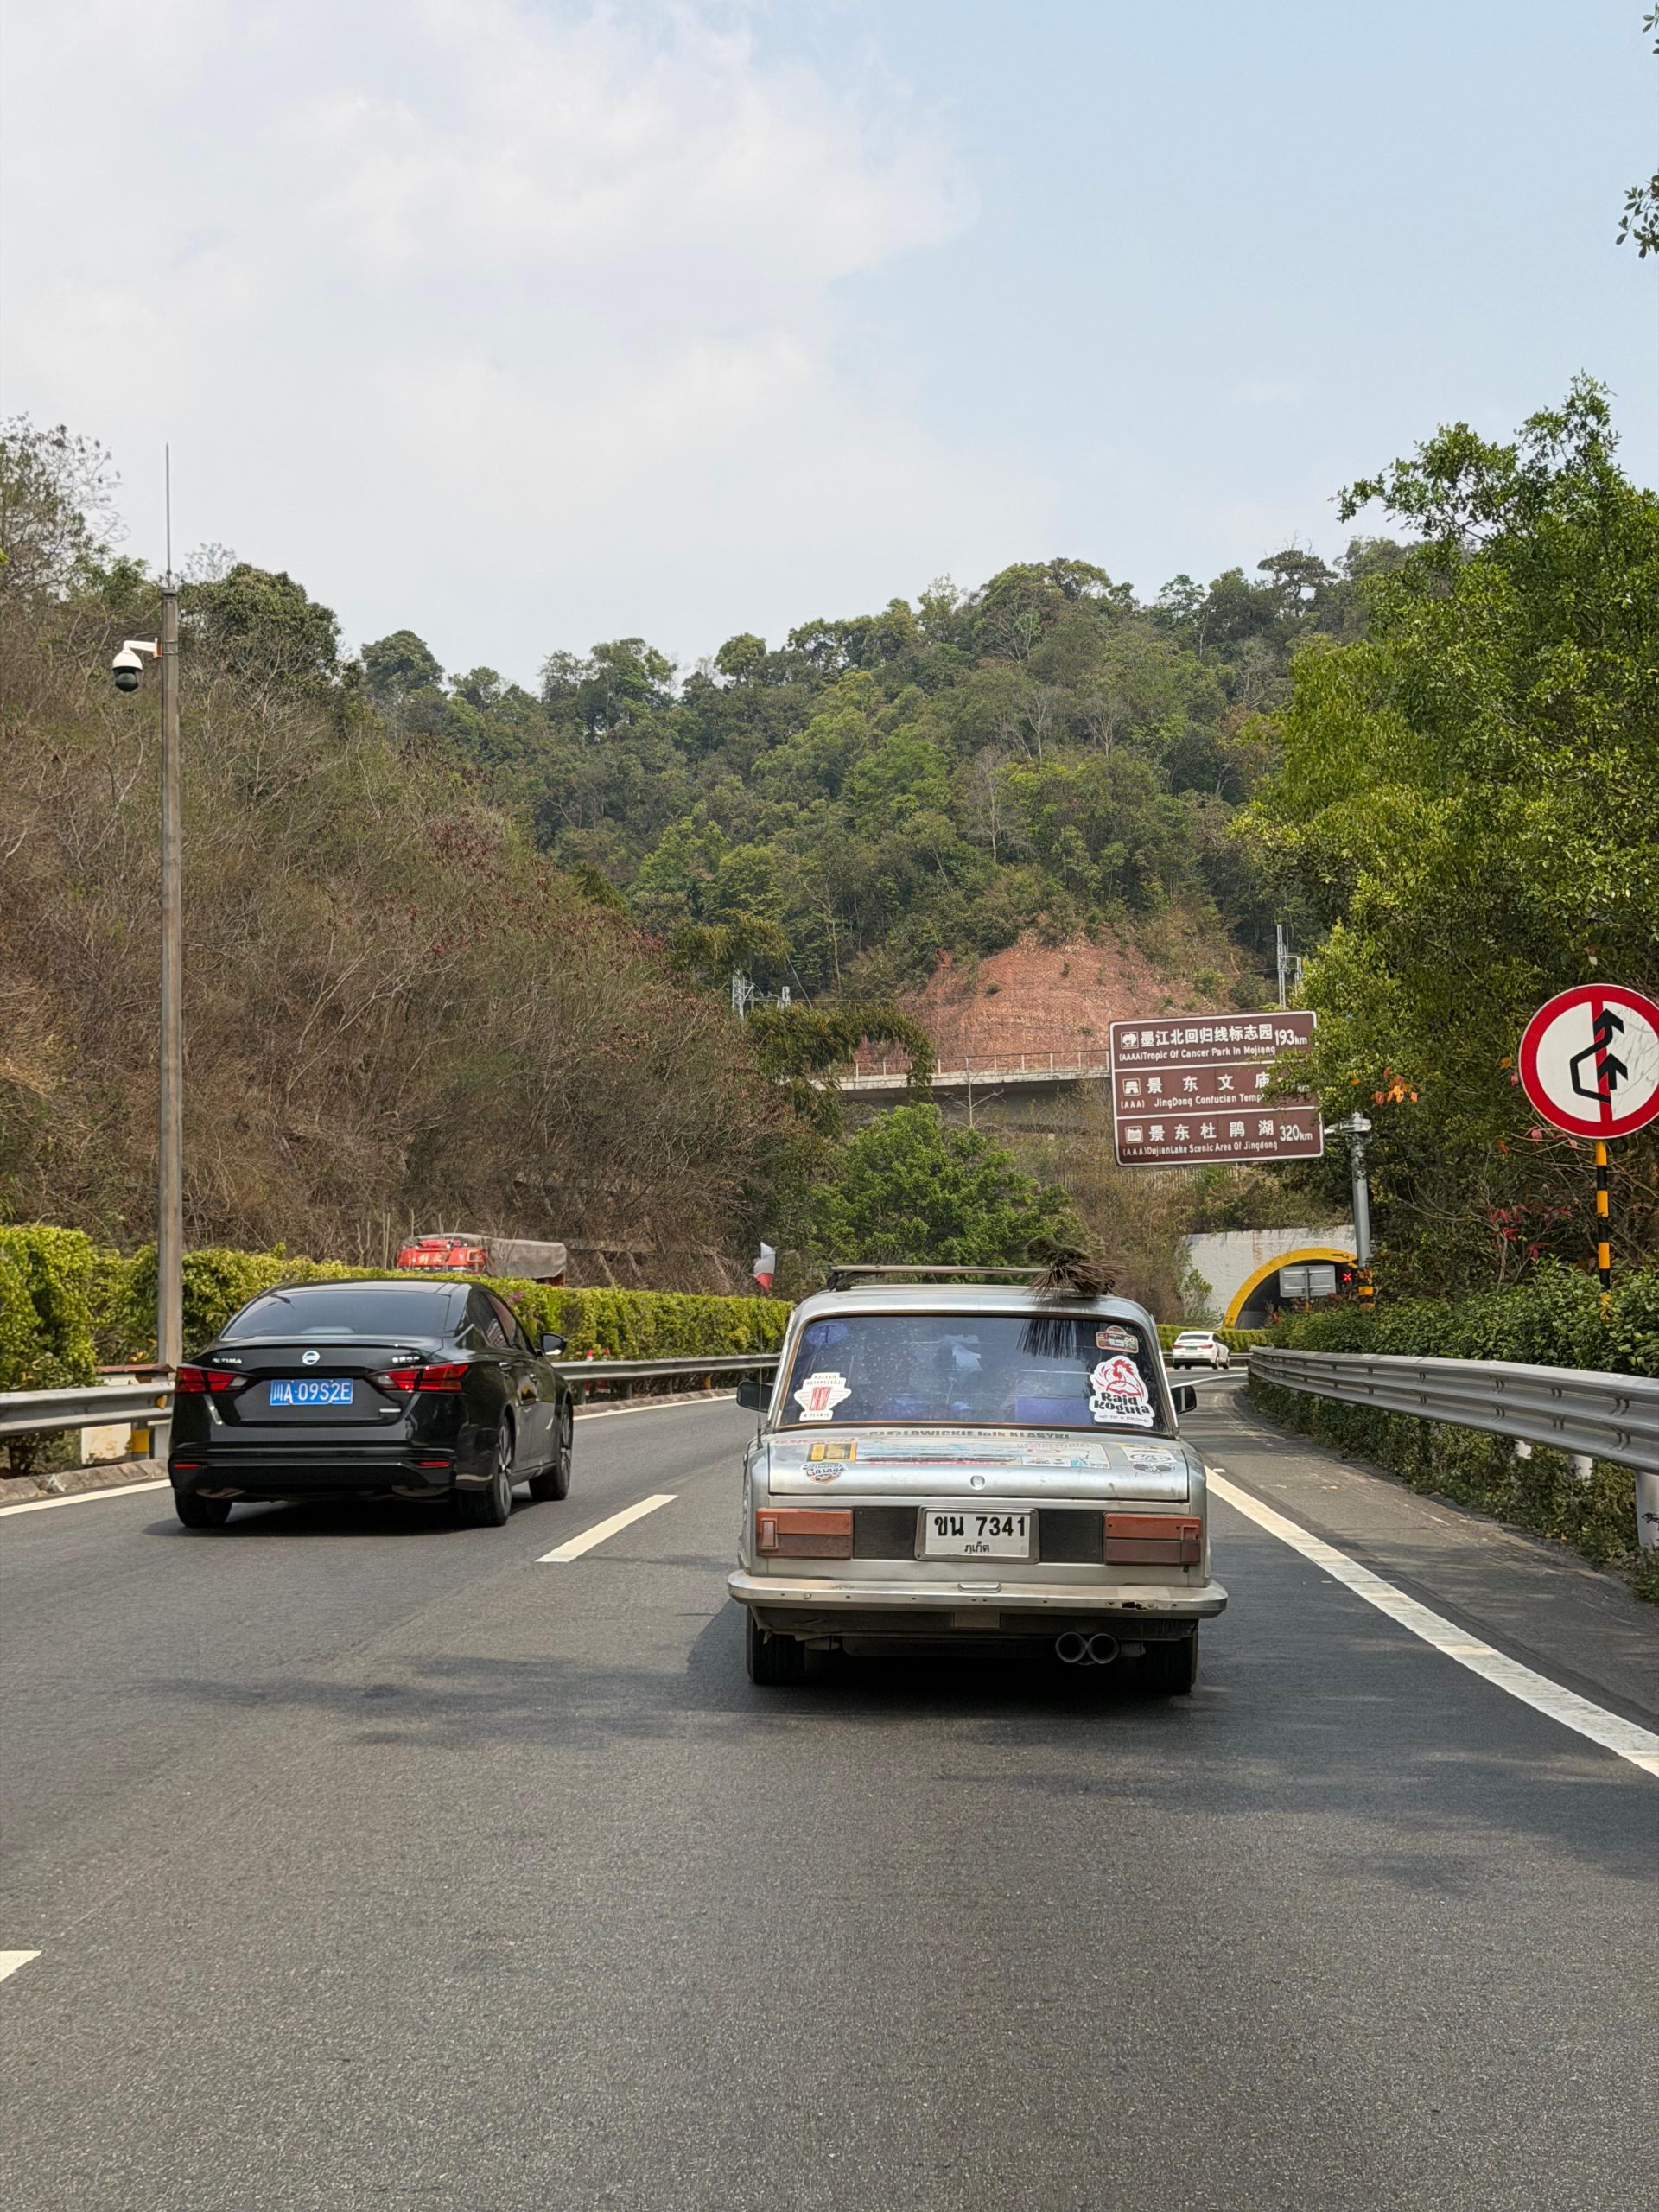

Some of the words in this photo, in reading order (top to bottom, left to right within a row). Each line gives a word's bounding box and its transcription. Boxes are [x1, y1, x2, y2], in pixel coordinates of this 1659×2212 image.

[1141, 1023, 1273, 1047] 墨江北回归线标志园
[1169, 1049, 1179, 1059] Of
[1180, 1048, 1210, 1058] Cancer
[1211, 1047, 1230, 1057] Park
[1243, 1045, 1275, 1056] Mojiang
[1121, 1099, 1145, 1109] (AAA)
[1154, 1097, 1192, 1109] JingDong
[1195, 1095, 1236, 1105] Confucian
[1148, 1120, 1274, 1141] 景东杜鹃湖
[1189, 1143, 1213, 1153] Scenic
[1215, 1141, 1232, 1152] Area
[1233, 1141, 1242, 1151] Of
[1243, 1141, 1278, 1152] Jingdong
[1101, 1392, 1138, 1406] Rajd
[1093, 1400, 1150, 1415] Koguta
[934, 1516, 964, 1536] ขน
[976, 1516, 1026, 1537] 7341
